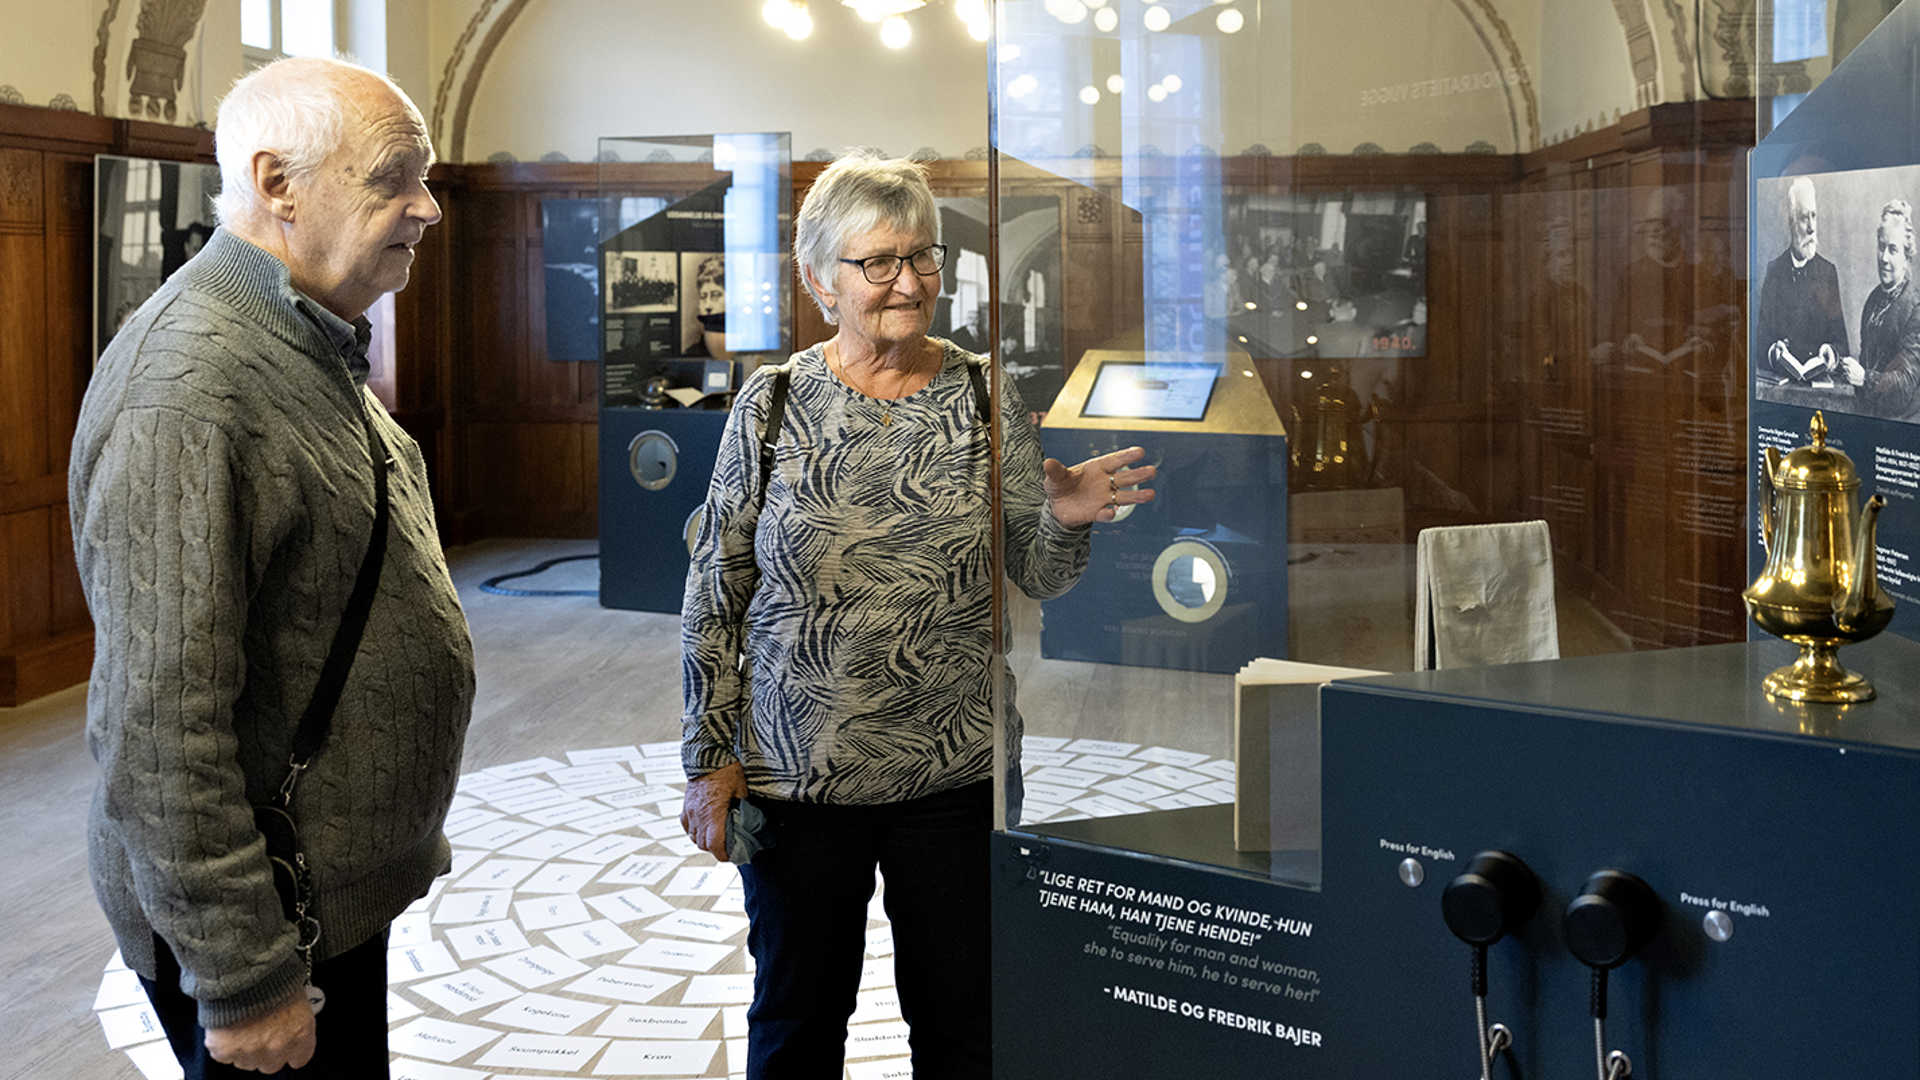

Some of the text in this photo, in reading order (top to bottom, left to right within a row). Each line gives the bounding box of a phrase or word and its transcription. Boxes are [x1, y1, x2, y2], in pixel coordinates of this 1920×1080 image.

[1380, 838, 1455, 862] Press for English
[1040, 870, 1073, 889] "LIGE
[1078, 879, 1105, 894] RET
[1106, 884, 1135, 901] FOR
[1138, 892, 1183, 911] MAND
[1188, 901, 1211, 916] OG
[1680, 891, 1769, 918] Press for English
[1039, 890, 1262, 946] TJENE HAM, HAN TJENE HENDE!"
[1083, 942, 1107, 958] she
[1111, 948, 1124, 961] to
[1128, 952, 1164, 970] serve
[1168, 959, 1197, 979] him,
[1202, 967, 1220, 982] he
[1224, 972, 1237, 986] to
[1241, 976, 1281, 996] serve
[1170, 938, 1191, 954] for
[1194, 947, 1226, 960] man
[1230, 952, 1258, 969] and
[1262, 960, 1320, 984] woman,
[1113, 986, 1177, 1013] MATILDE
[1180, 1003, 1204, 1020] OG
[1208, 1009, 1271, 1035] FREDRIK
[1275, 1025, 1321, 1047] BAJER
